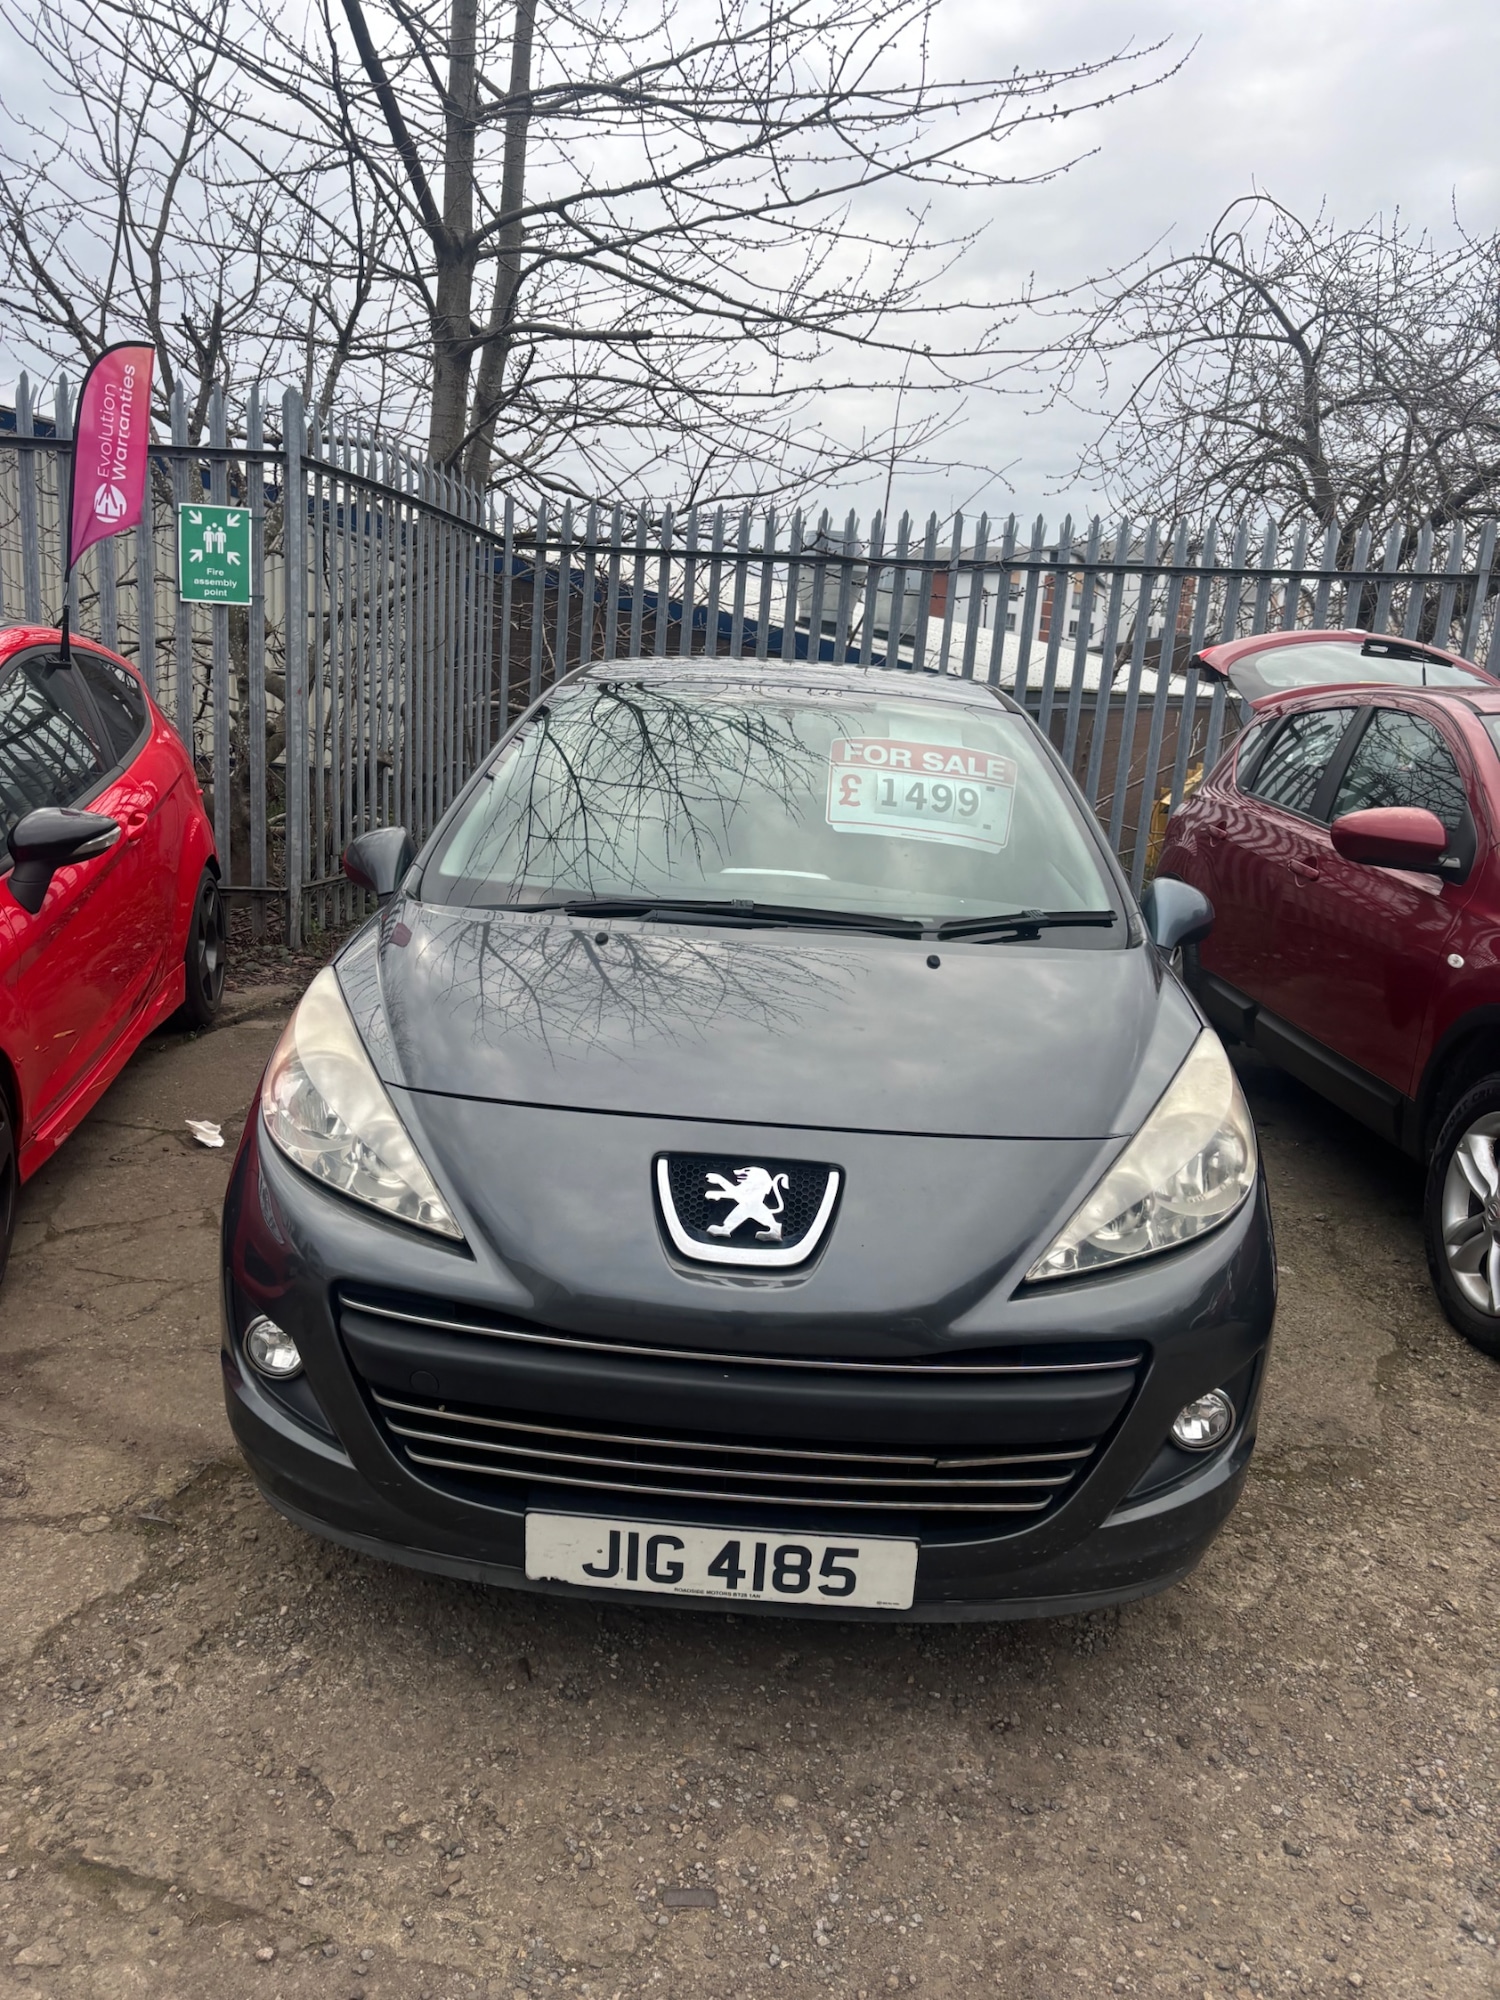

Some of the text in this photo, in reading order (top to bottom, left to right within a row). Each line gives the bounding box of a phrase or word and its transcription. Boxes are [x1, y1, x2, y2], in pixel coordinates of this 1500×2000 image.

[97, 383, 116, 478] Evolution
[112, 364, 136, 481] Warranties
[193, 578, 237, 589] assembly
[206, 567, 224, 576] Fire
[204, 588, 227, 597] point
[844, 743, 1005, 780] FOR SALE
[582, 1529, 859, 1597] JIG 4185
[674, 1587, 704, 1595] ROADSIDE
